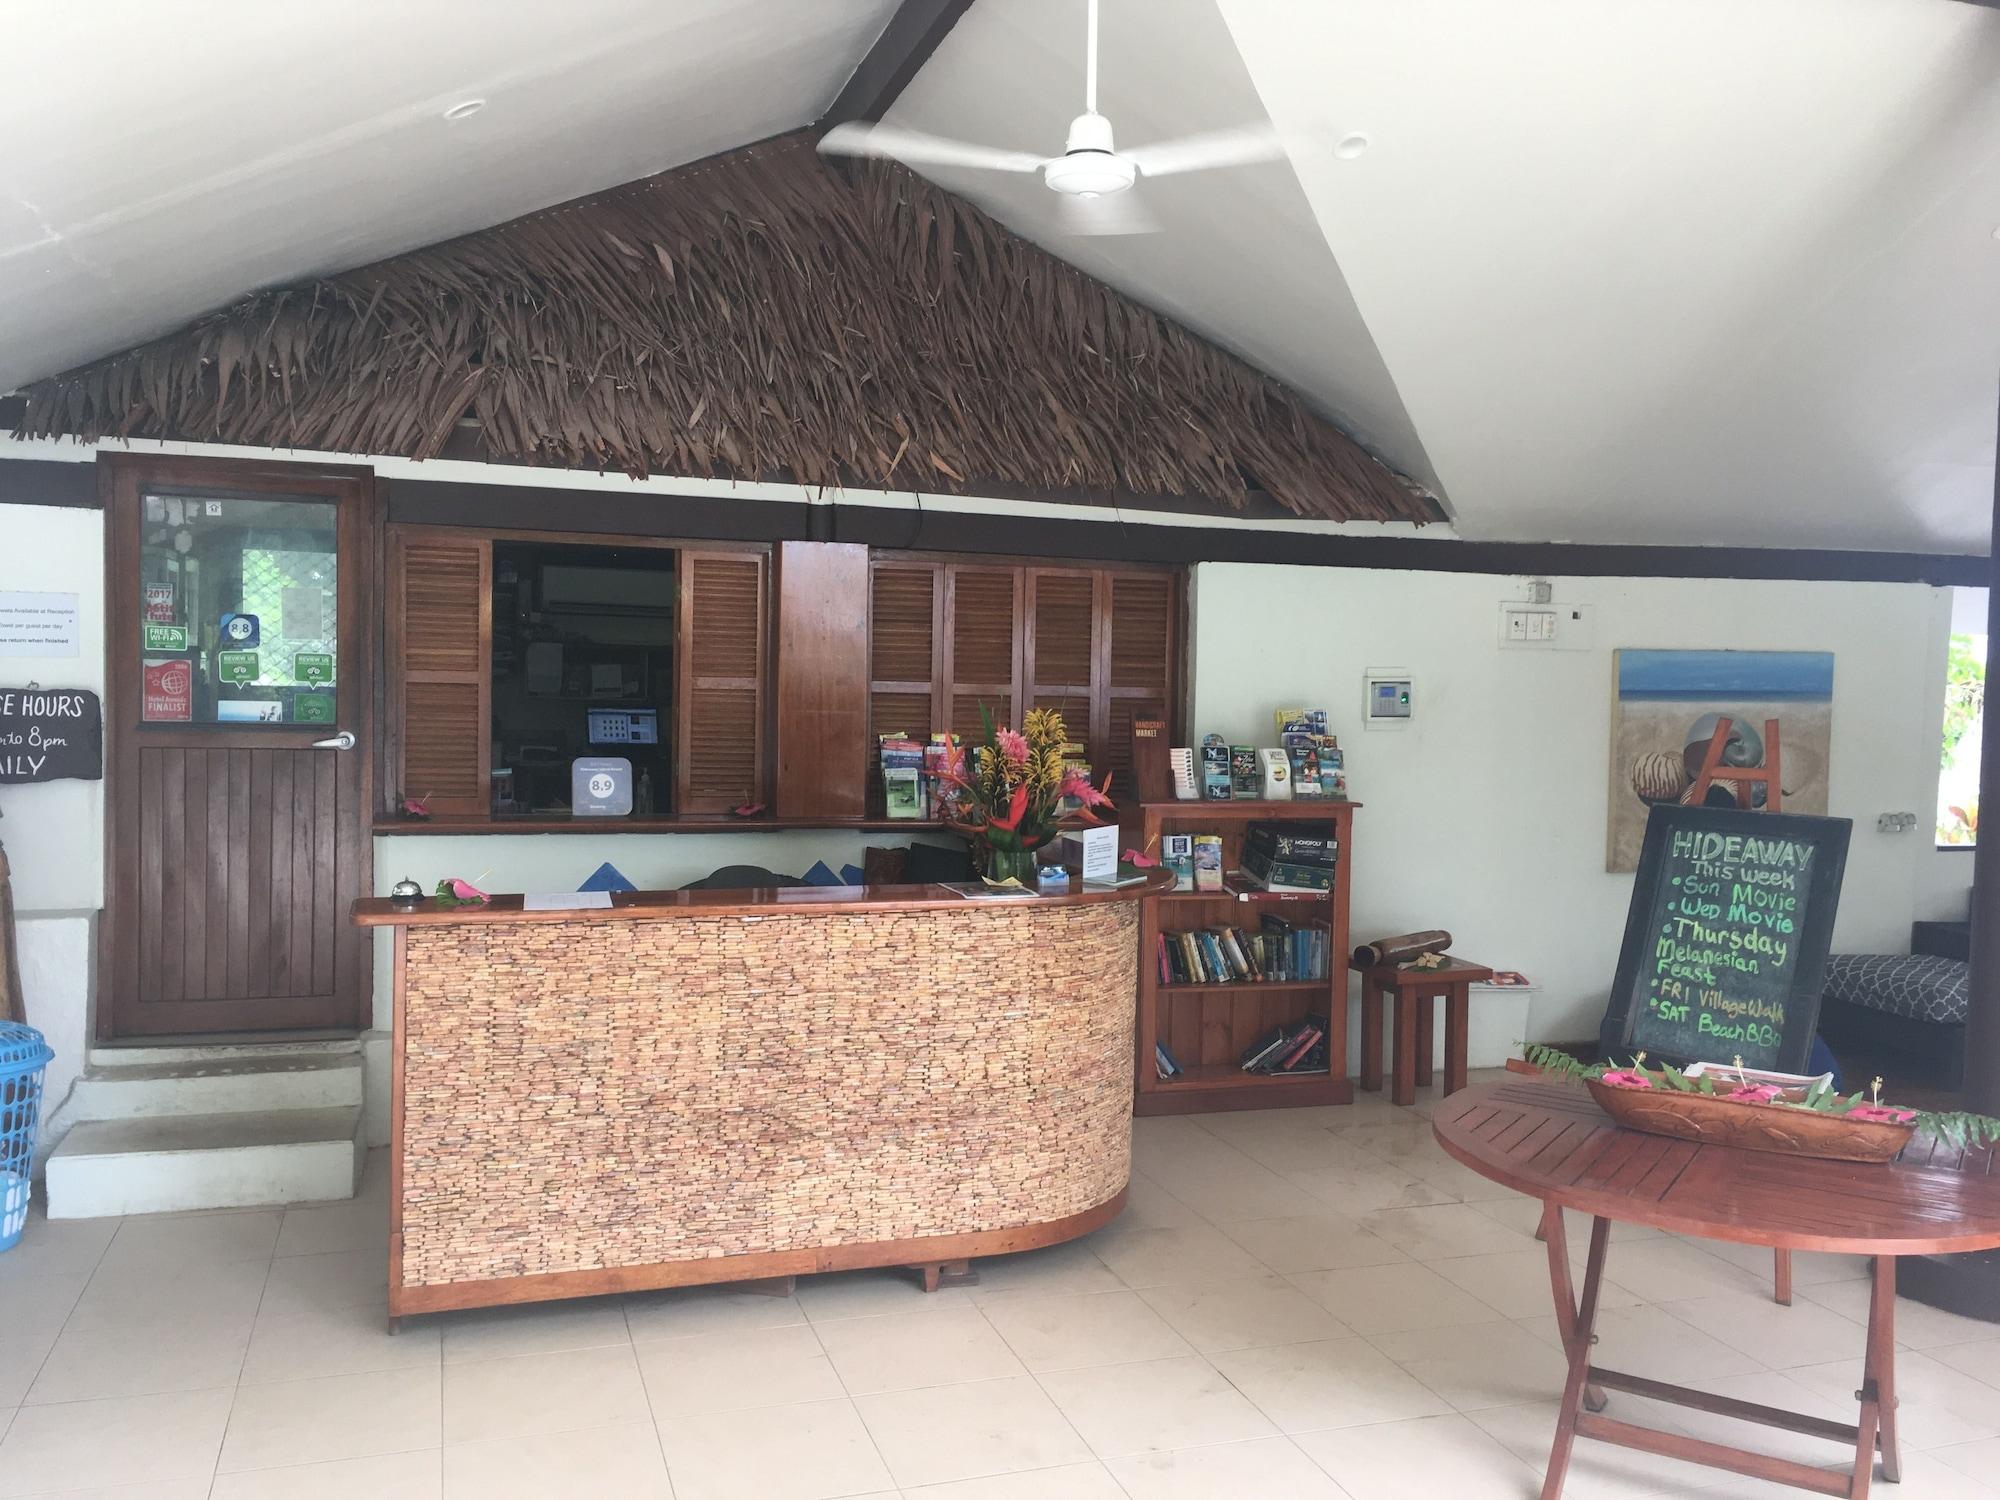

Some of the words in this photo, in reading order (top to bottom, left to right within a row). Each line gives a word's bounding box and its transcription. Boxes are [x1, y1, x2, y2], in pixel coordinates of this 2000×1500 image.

[147, 590, 172, 599] 2017
[22, 695, 84, 717] HOURS
[148, 702, 186, 711] FINALIST
[1135, 729, 1157, 738] MARKET
[1294, 839, 1322, 847] MONOPOLY
[1691, 860, 1735, 880] This
[1732, 883, 1796, 911] Movie
[1727, 903, 1794, 934] Movie
[1673, 917, 1787, 967] Thursday
[1656, 936, 1759, 975] Melanesian
[1657, 959, 1716, 986] Feast
[1660, 978, 1690, 1004] FRI
[1657, 1000, 1691, 1023] SAT
[1698, 1013, 1745, 1042] Beach
